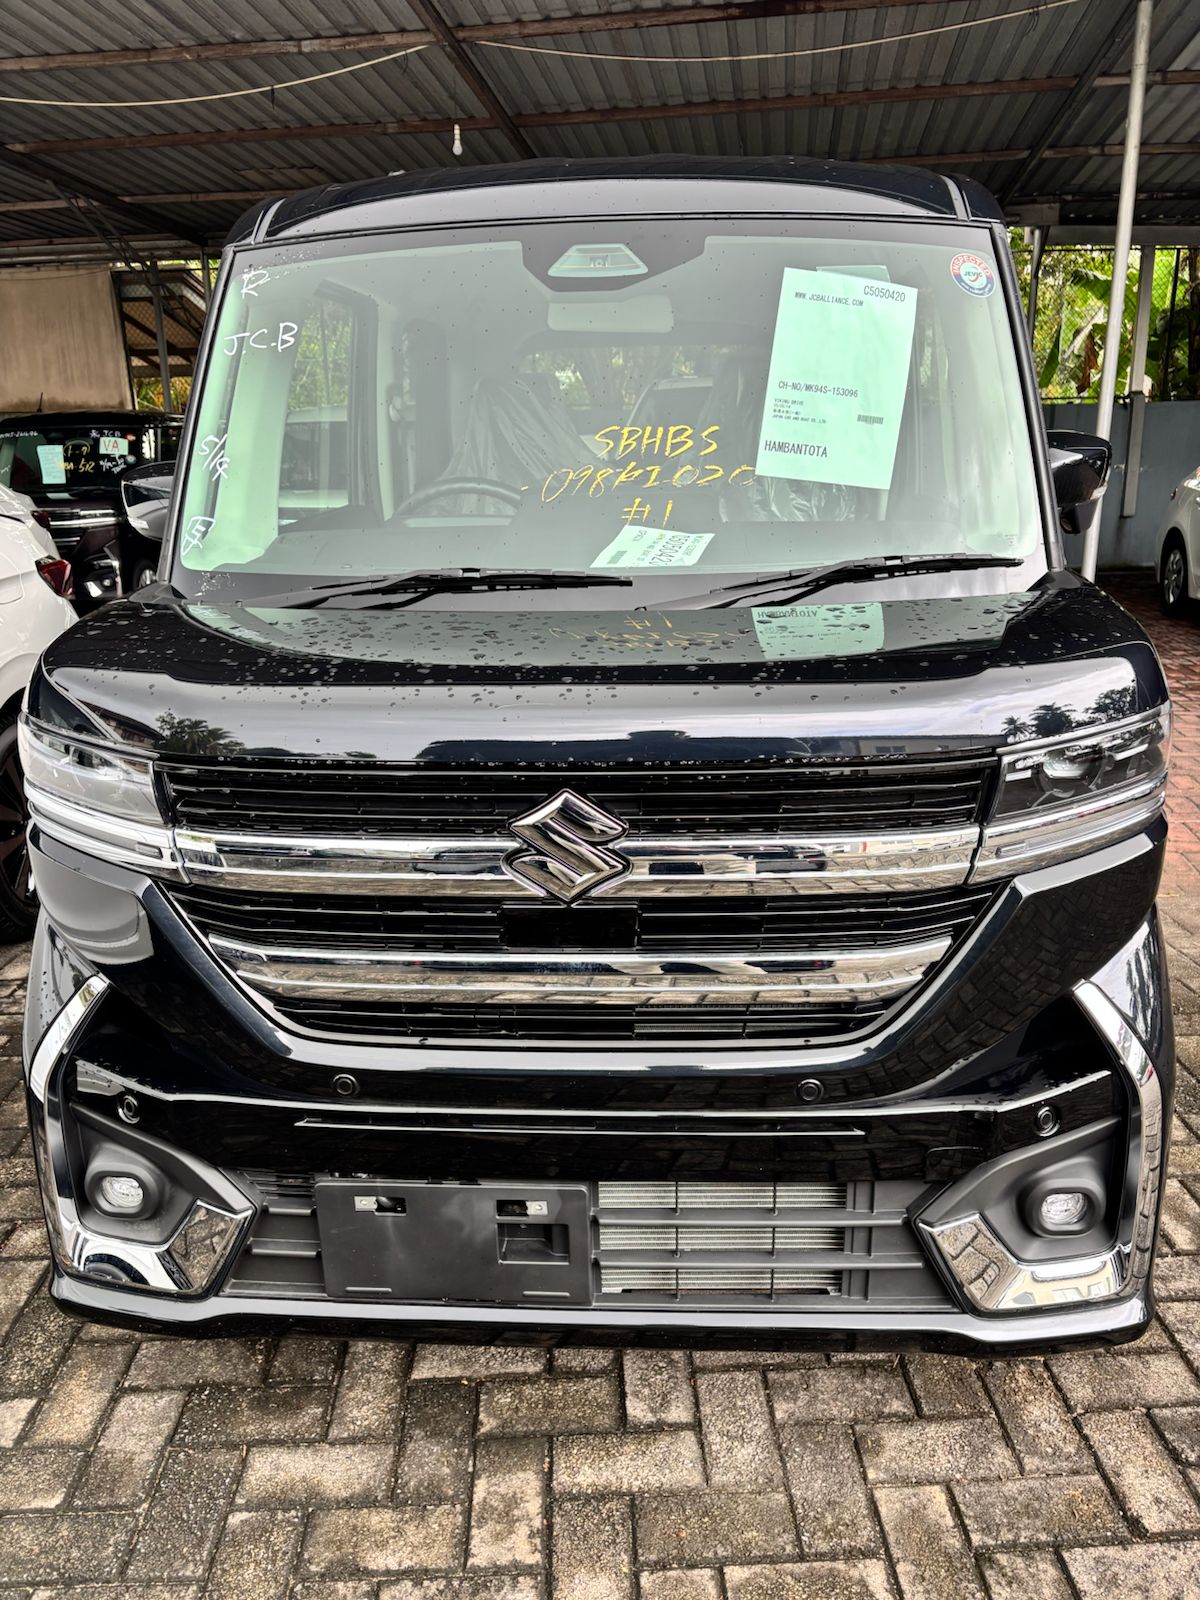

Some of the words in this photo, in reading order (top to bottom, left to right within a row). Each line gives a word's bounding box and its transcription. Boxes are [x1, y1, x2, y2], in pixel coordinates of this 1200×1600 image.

[863, 285, 906, 302] C5050420
[778, 380, 859, 398] CH-NO/MK94S-153096
[594, 425, 720, 458] SBHBS
[764, 440, 828, 458] HAMBANTOTA
